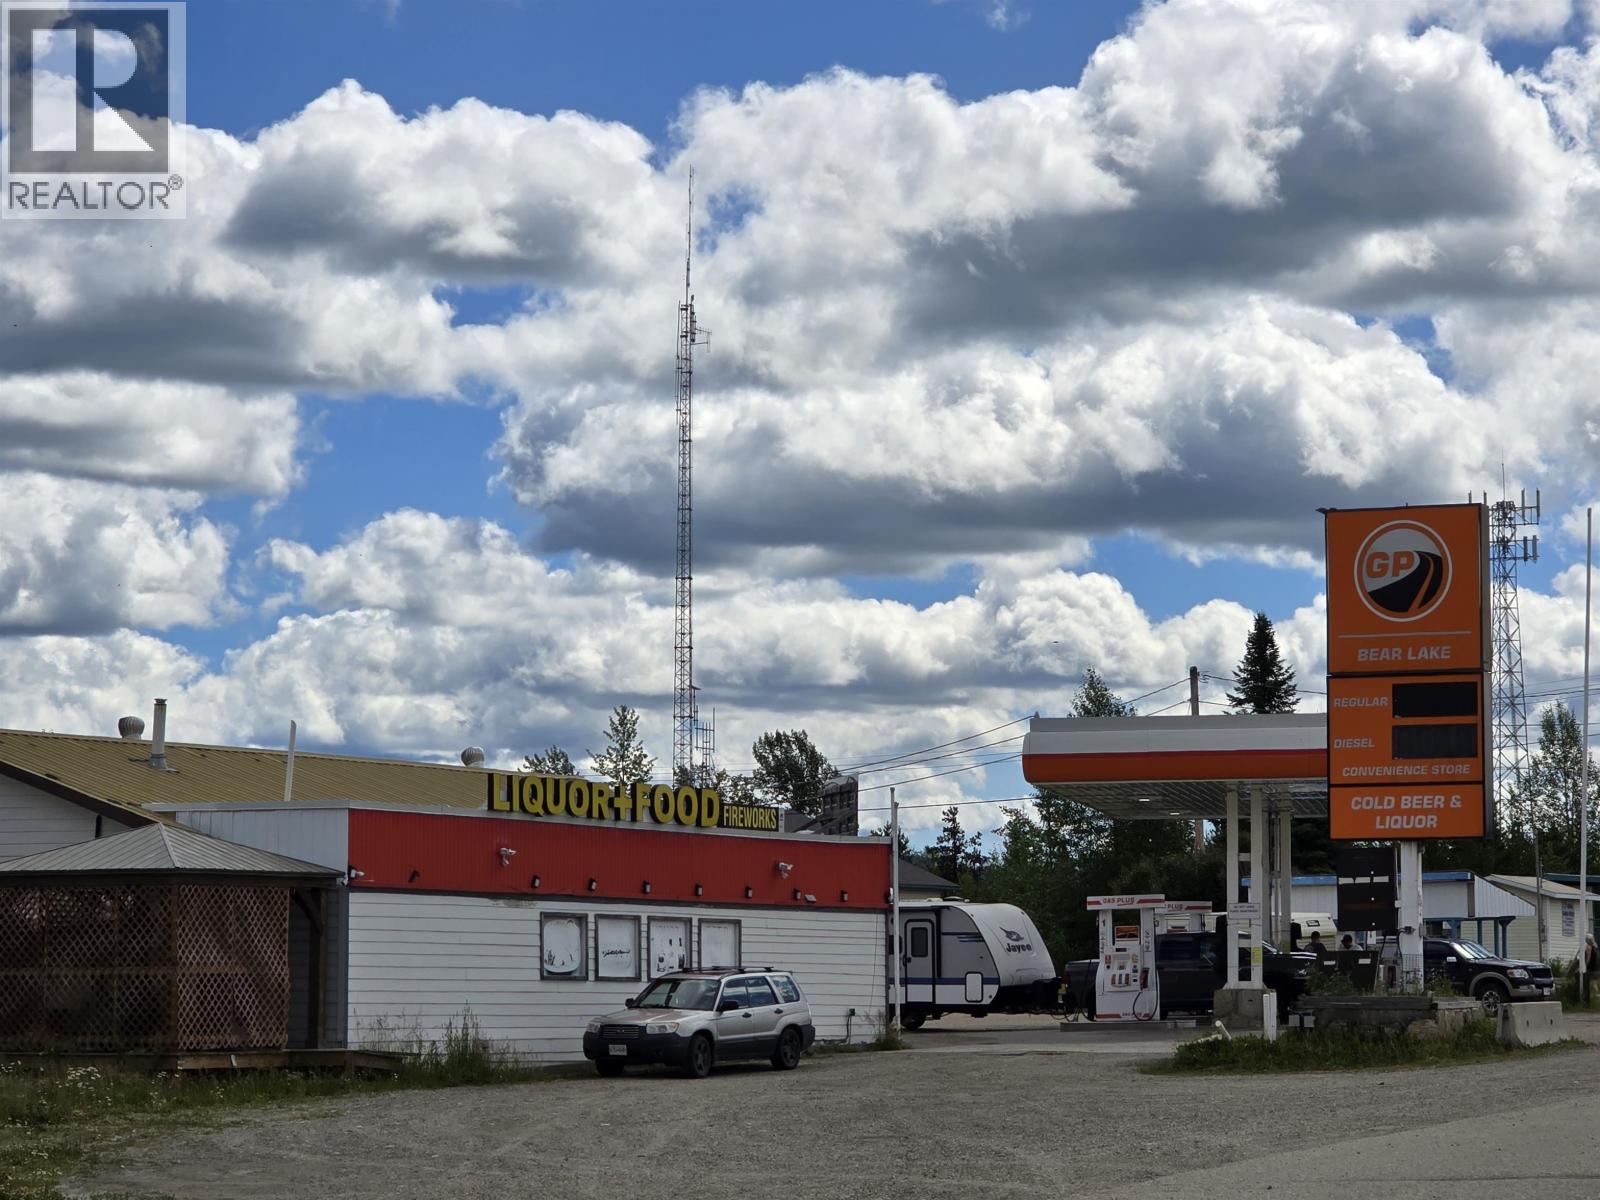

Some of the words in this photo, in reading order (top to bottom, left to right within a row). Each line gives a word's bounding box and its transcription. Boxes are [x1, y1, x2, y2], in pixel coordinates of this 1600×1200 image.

[1366, 550, 1417, 579] GP
[1357, 648, 1402, 662] BEAR
[1407, 646, 1451, 661] LAKE
[1333, 696, 1389, 708] REGULAR
[1333, 738, 1375, 749] DIESEL
[1342, 765, 1429, 777] CONVENIENCE
[1431, 764, 1471, 775] STORE
[1351, 796, 1396, 811] COLD
[1400, 795, 1445, 809] BEER
[1449, 794, 1462, 808] &
[723, 803, 778, 830] FIREWORKS
[1375, 814, 1438, 830] LIQUOR
[1006, 943, 1032, 953] Jayco
